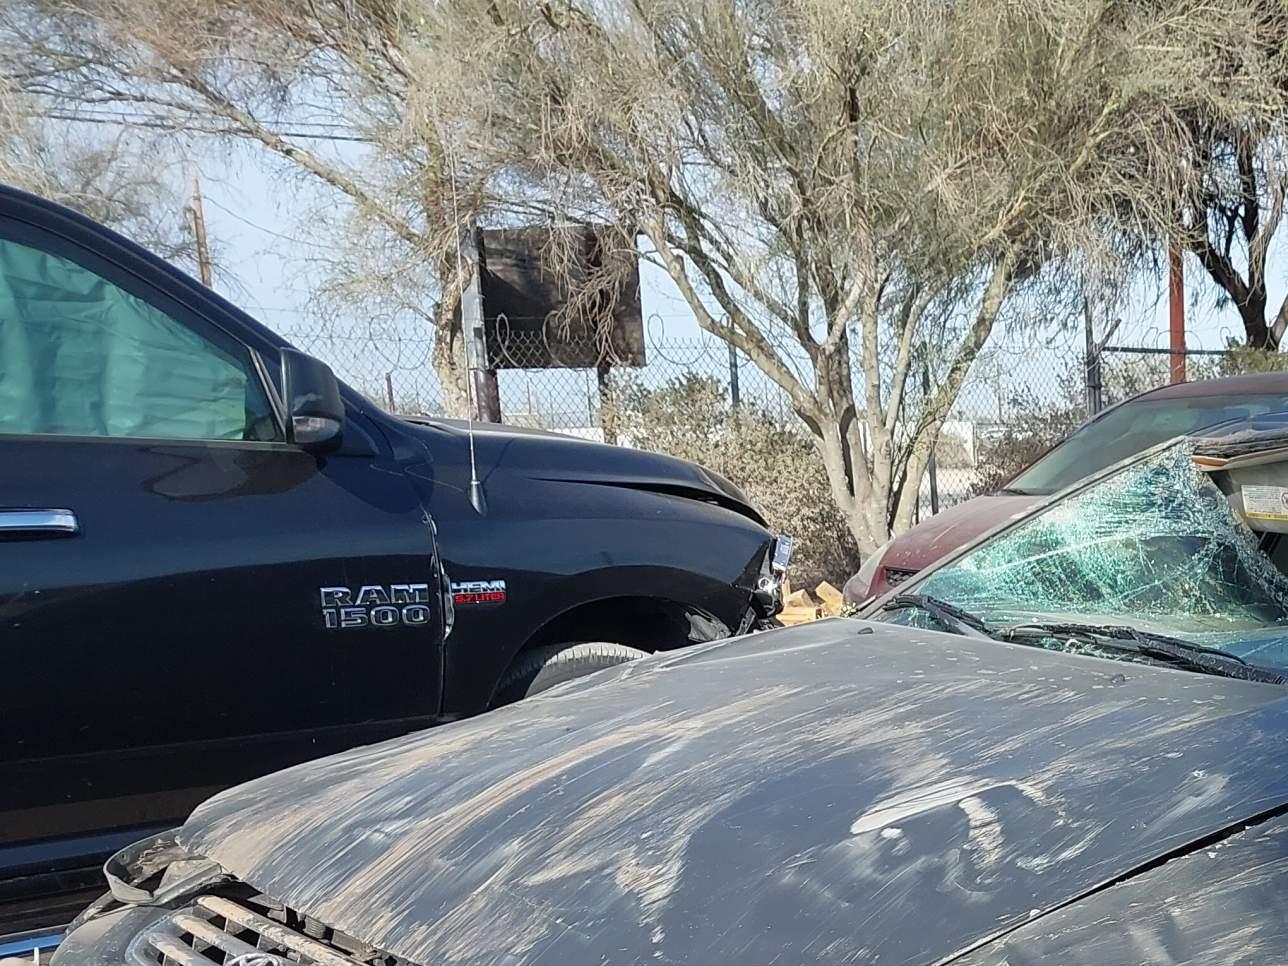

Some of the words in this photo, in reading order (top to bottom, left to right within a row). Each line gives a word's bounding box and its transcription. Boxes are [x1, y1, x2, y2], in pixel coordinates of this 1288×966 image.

[320, 584, 429, 606] RAM
[451, 580, 506, 593] HEMI
[322, 605, 431, 628] 1500
